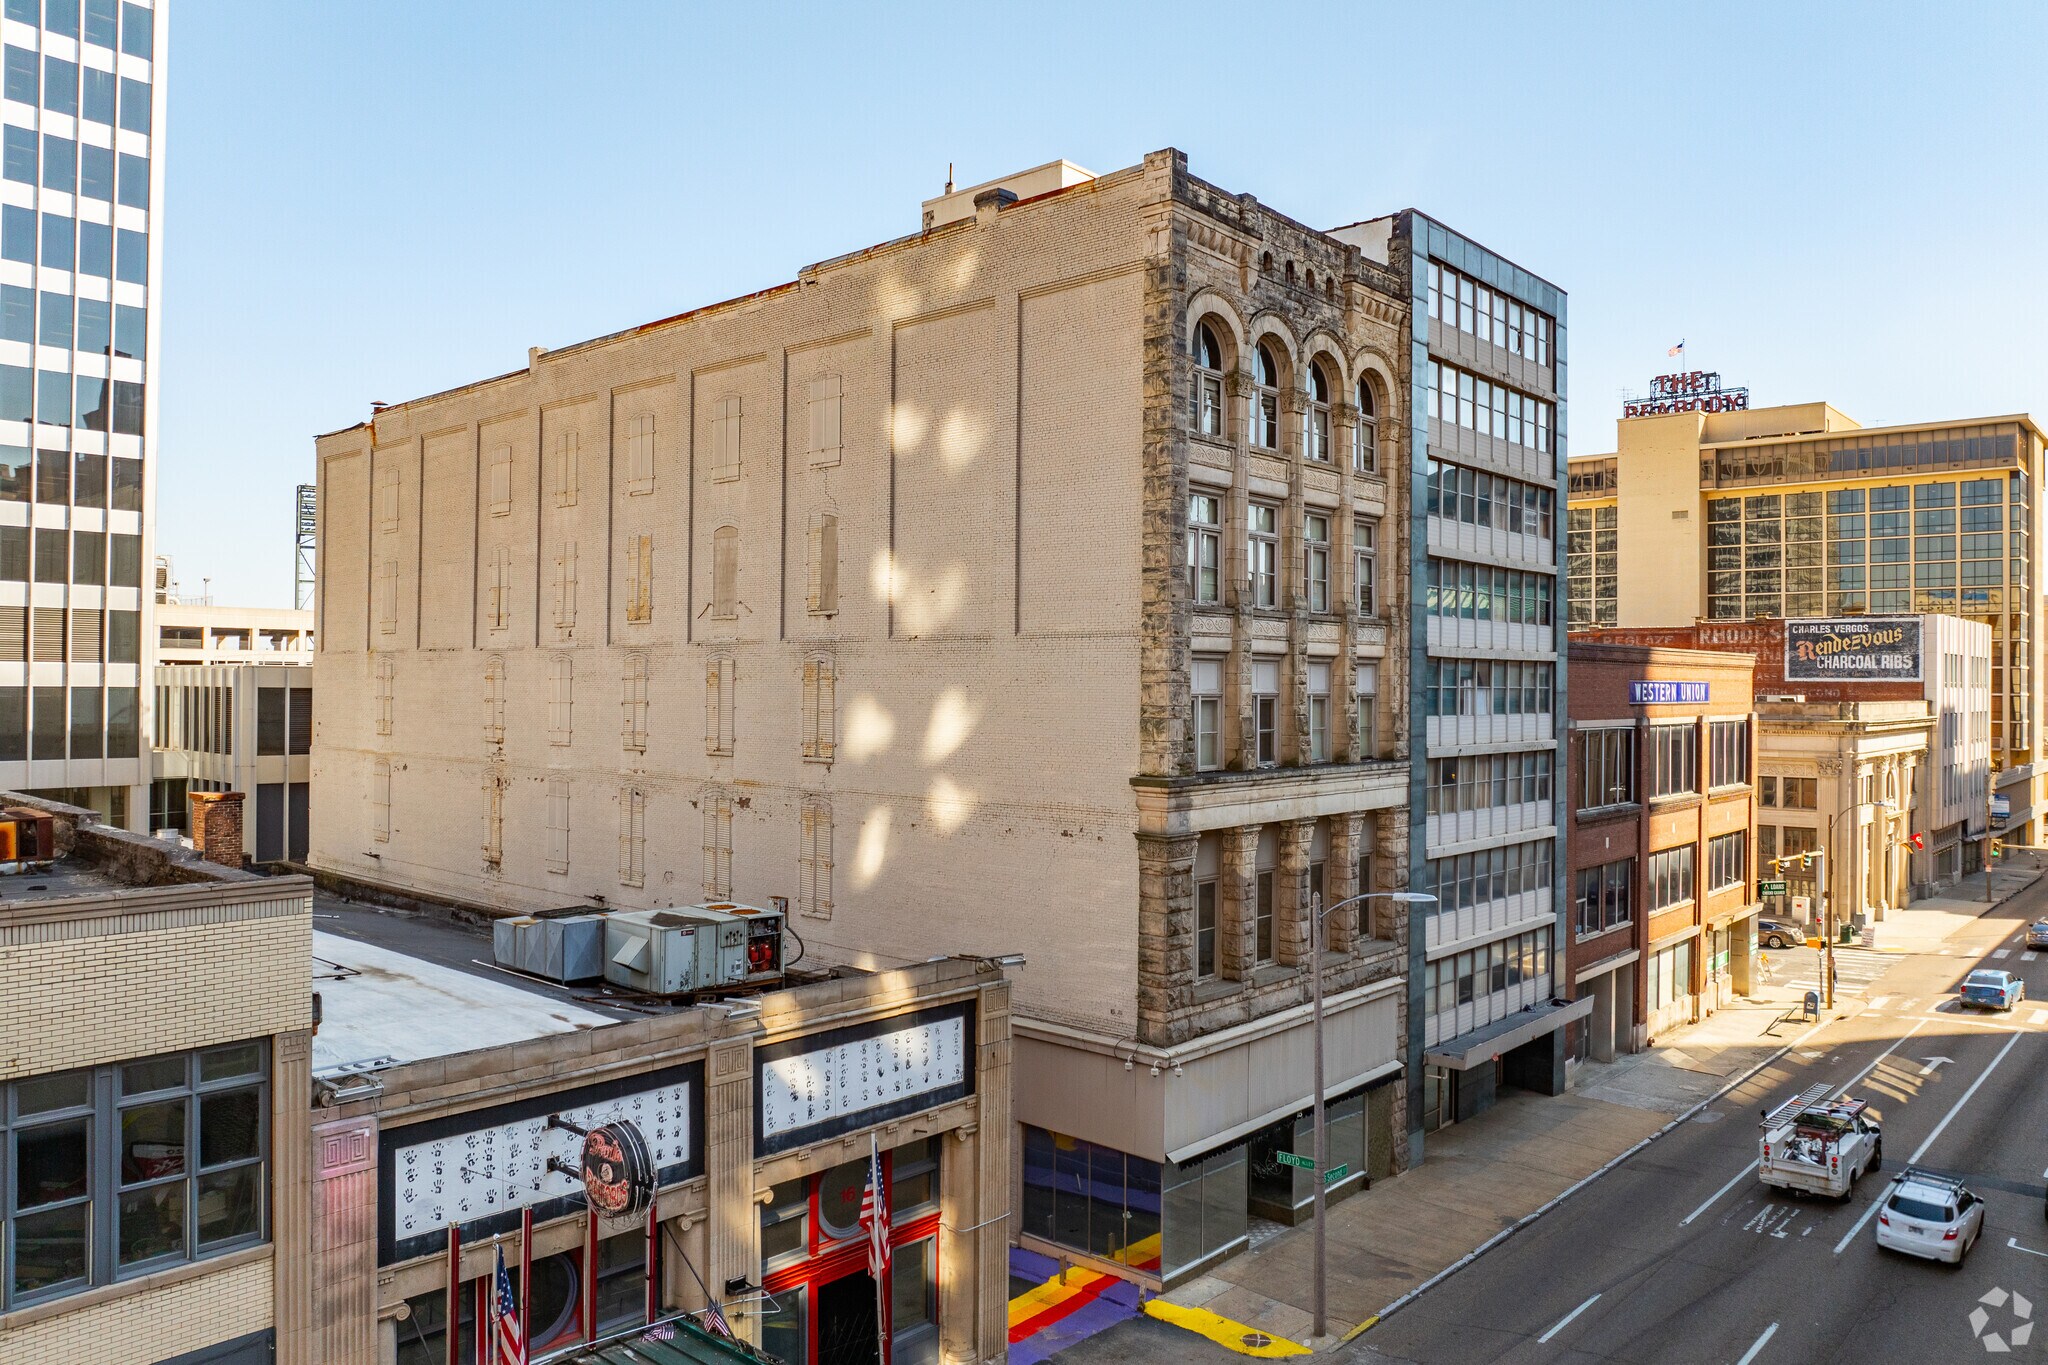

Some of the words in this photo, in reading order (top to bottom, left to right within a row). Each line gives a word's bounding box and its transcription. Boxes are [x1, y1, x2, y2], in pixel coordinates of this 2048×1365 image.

[1655, 371, 1704, 392] THE
[1792, 624, 1831, 634] CHARLES
[1834, 624, 1869, 633] VERGOS
[1795, 627, 1903, 660] Rendezvous
[1816, 654, 1878, 669] CHARCOAL
[1880, 654, 1914, 669] RIBS
[1635, 682, 1677, 701] WESTERN
[1681, 682, 1706, 701] UNION
[1278, 1153, 1300, 1166] FLOYD
